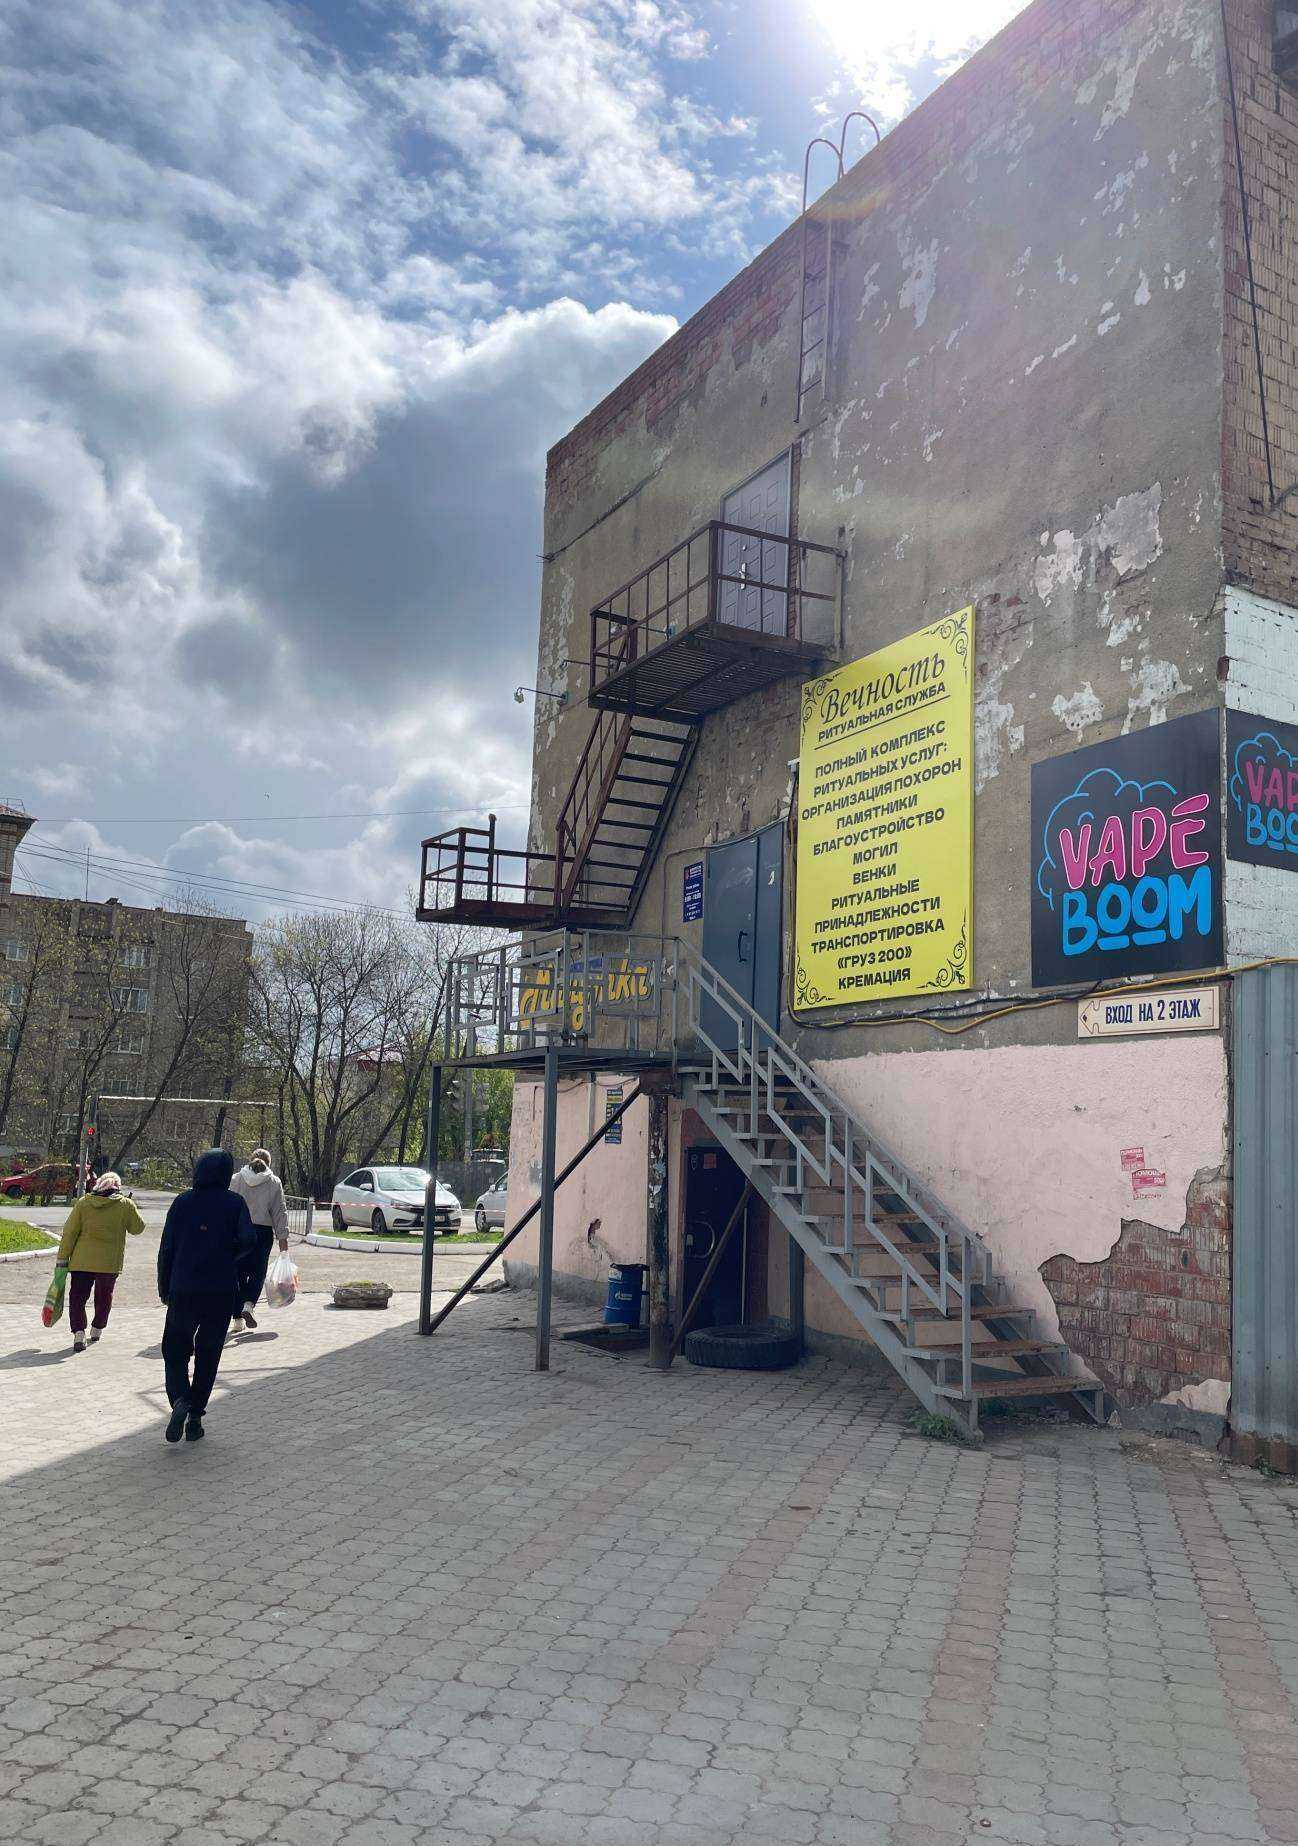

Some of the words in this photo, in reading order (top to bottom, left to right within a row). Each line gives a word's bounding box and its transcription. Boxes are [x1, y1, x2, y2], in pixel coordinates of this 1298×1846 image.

[821, 653, 945, 724] Вечность
[818, 704, 893, 742] РИТУАЛЬНАЯ
[895, 681, 945, 711] СЛУЖБА
[815, 747, 867, 778] ПОЛНЫЙ
[870, 720, 945, 759] КОМПЛЕКС
[813, 760, 899, 798] РИТУАЛЬНЫХ
[900, 741, 947, 770] УСЛУГ:
[801, 781, 892, 821] ОРГАНИЗАЦИЯ
[894, 758, 962, 790] ПОХОРОН
[836, 793, 918, 830] ПАМЯТНИКИ
[813, 807, 945, 856] БЛАГОУСТРОЙСТВО
[852, 841, 898, 865] МОГИЛ
[852, 863, 896, 885] ВЕНКИ
[831, 879, 920, 910] РИТУАЛЬНЫЕ
[1063, 865, 1212, 956] BOOM
[814, 896, 941, 934] ПРИНАДЛЕЖНОСТИ
[811, 918, 945, 954] ТРАНСПОРТИРОВКА
[837, 952, 876, 970] «ГРУЗ
[878, 945, 912, 964] 200»
[838, 967, 911, 990] КРЕМАЦИЯ
[1105, 1004, 1133, 1024] ВХОД
[1138, 1003, 1154, 1022] НА
[1157, 1000, 1165, 1021] 2
[1168, 998, 1200, 1019] ЭТАЖ
